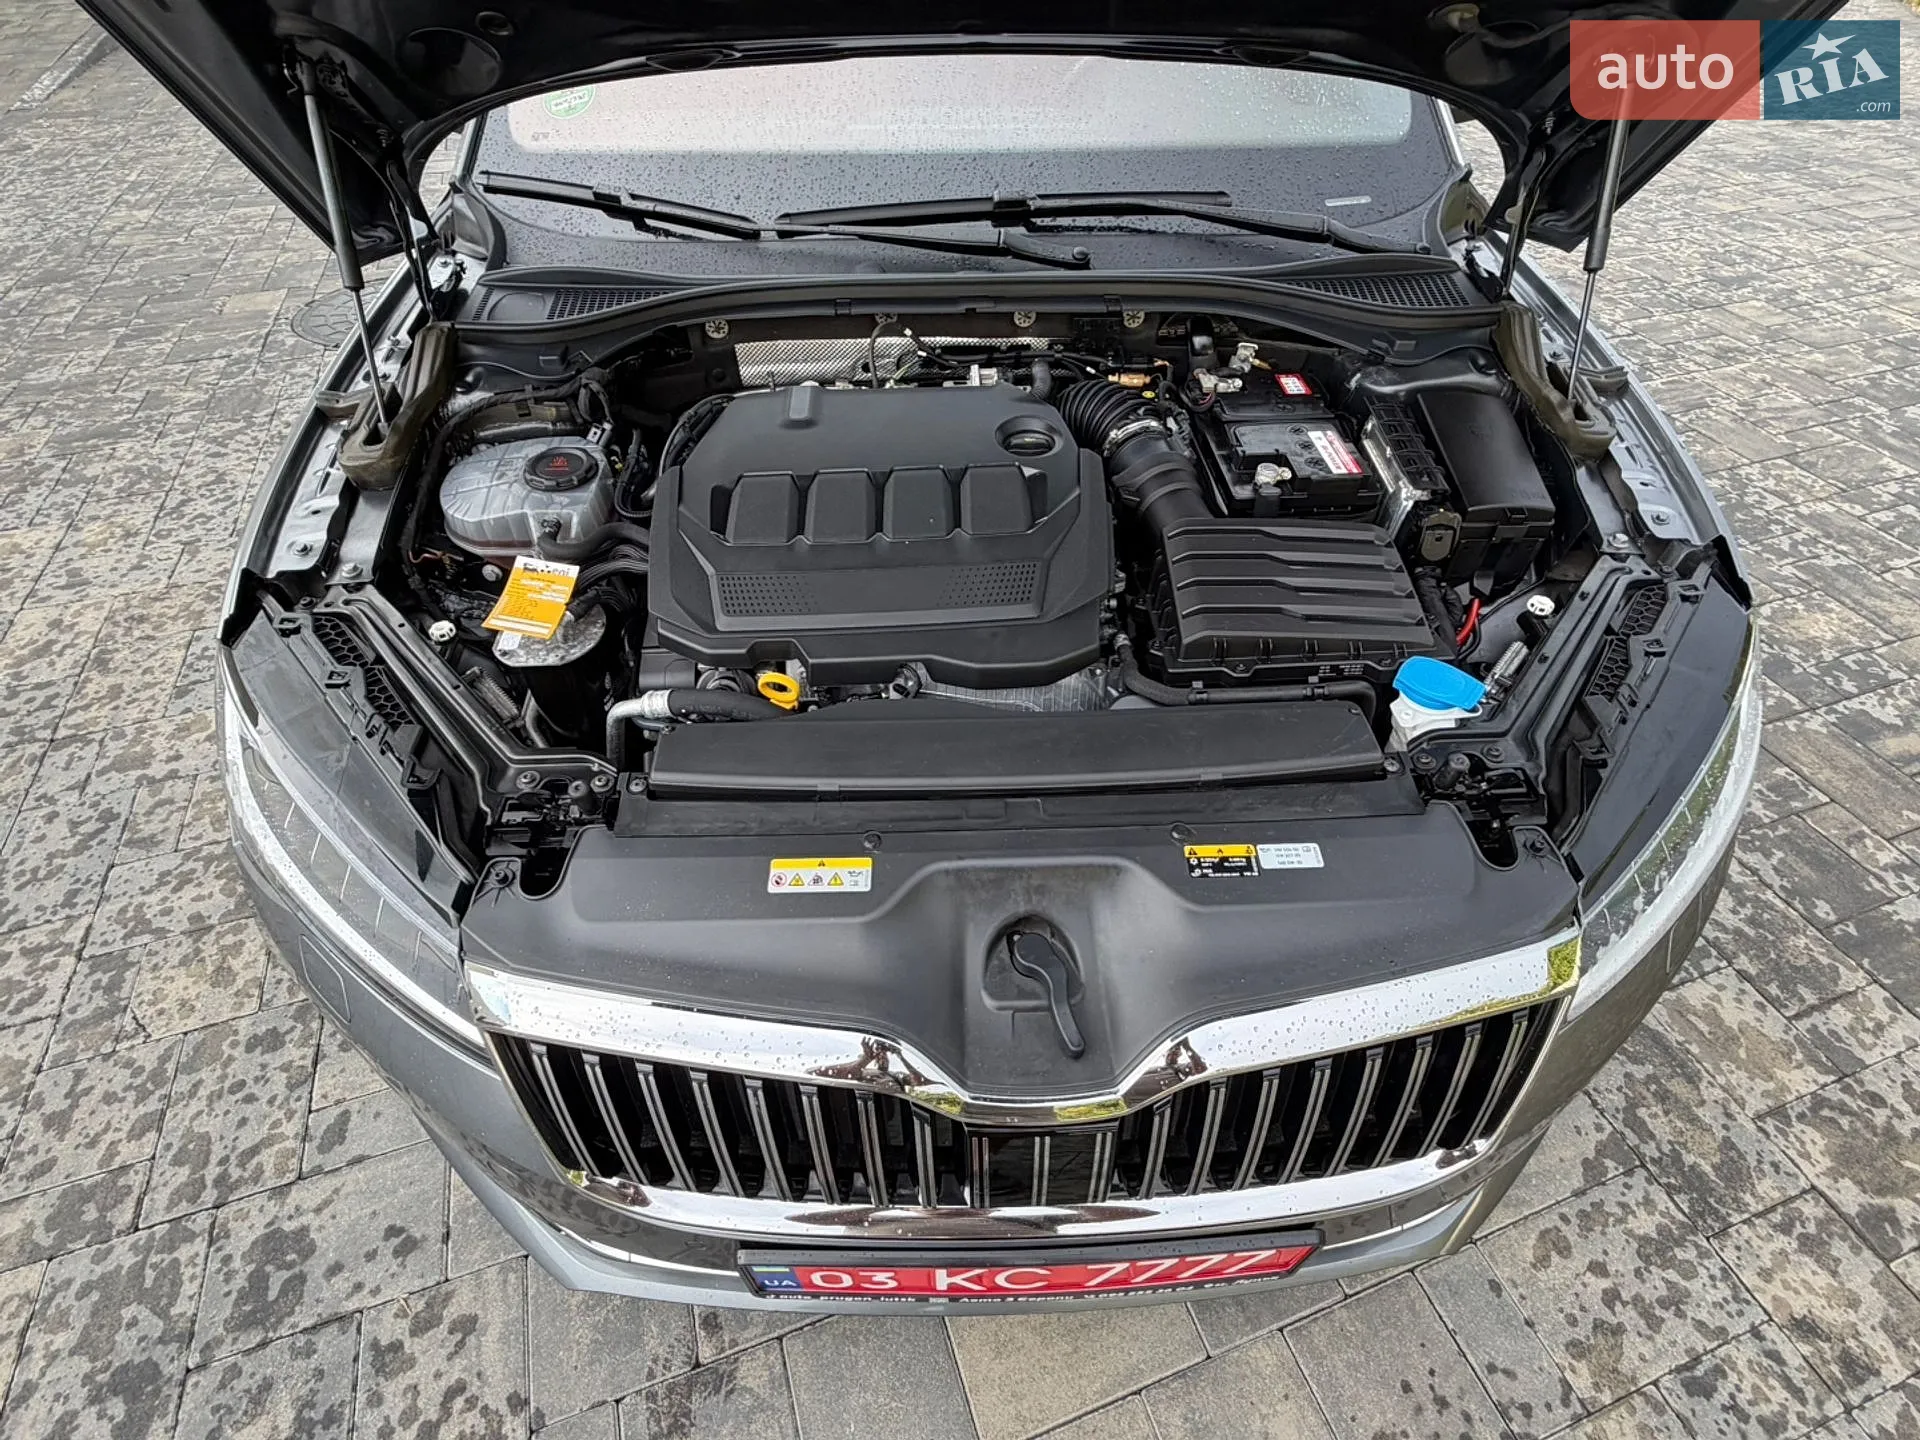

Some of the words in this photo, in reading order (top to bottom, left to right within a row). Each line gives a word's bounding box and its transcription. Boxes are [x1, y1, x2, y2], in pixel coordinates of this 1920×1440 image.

[810, 1271, 898, 1289] 03
[935, 1268, 1051, 1290] KC
[1084, 1250, 1277, 1287] 7777
[763, 1279, 797, 1287] UA
